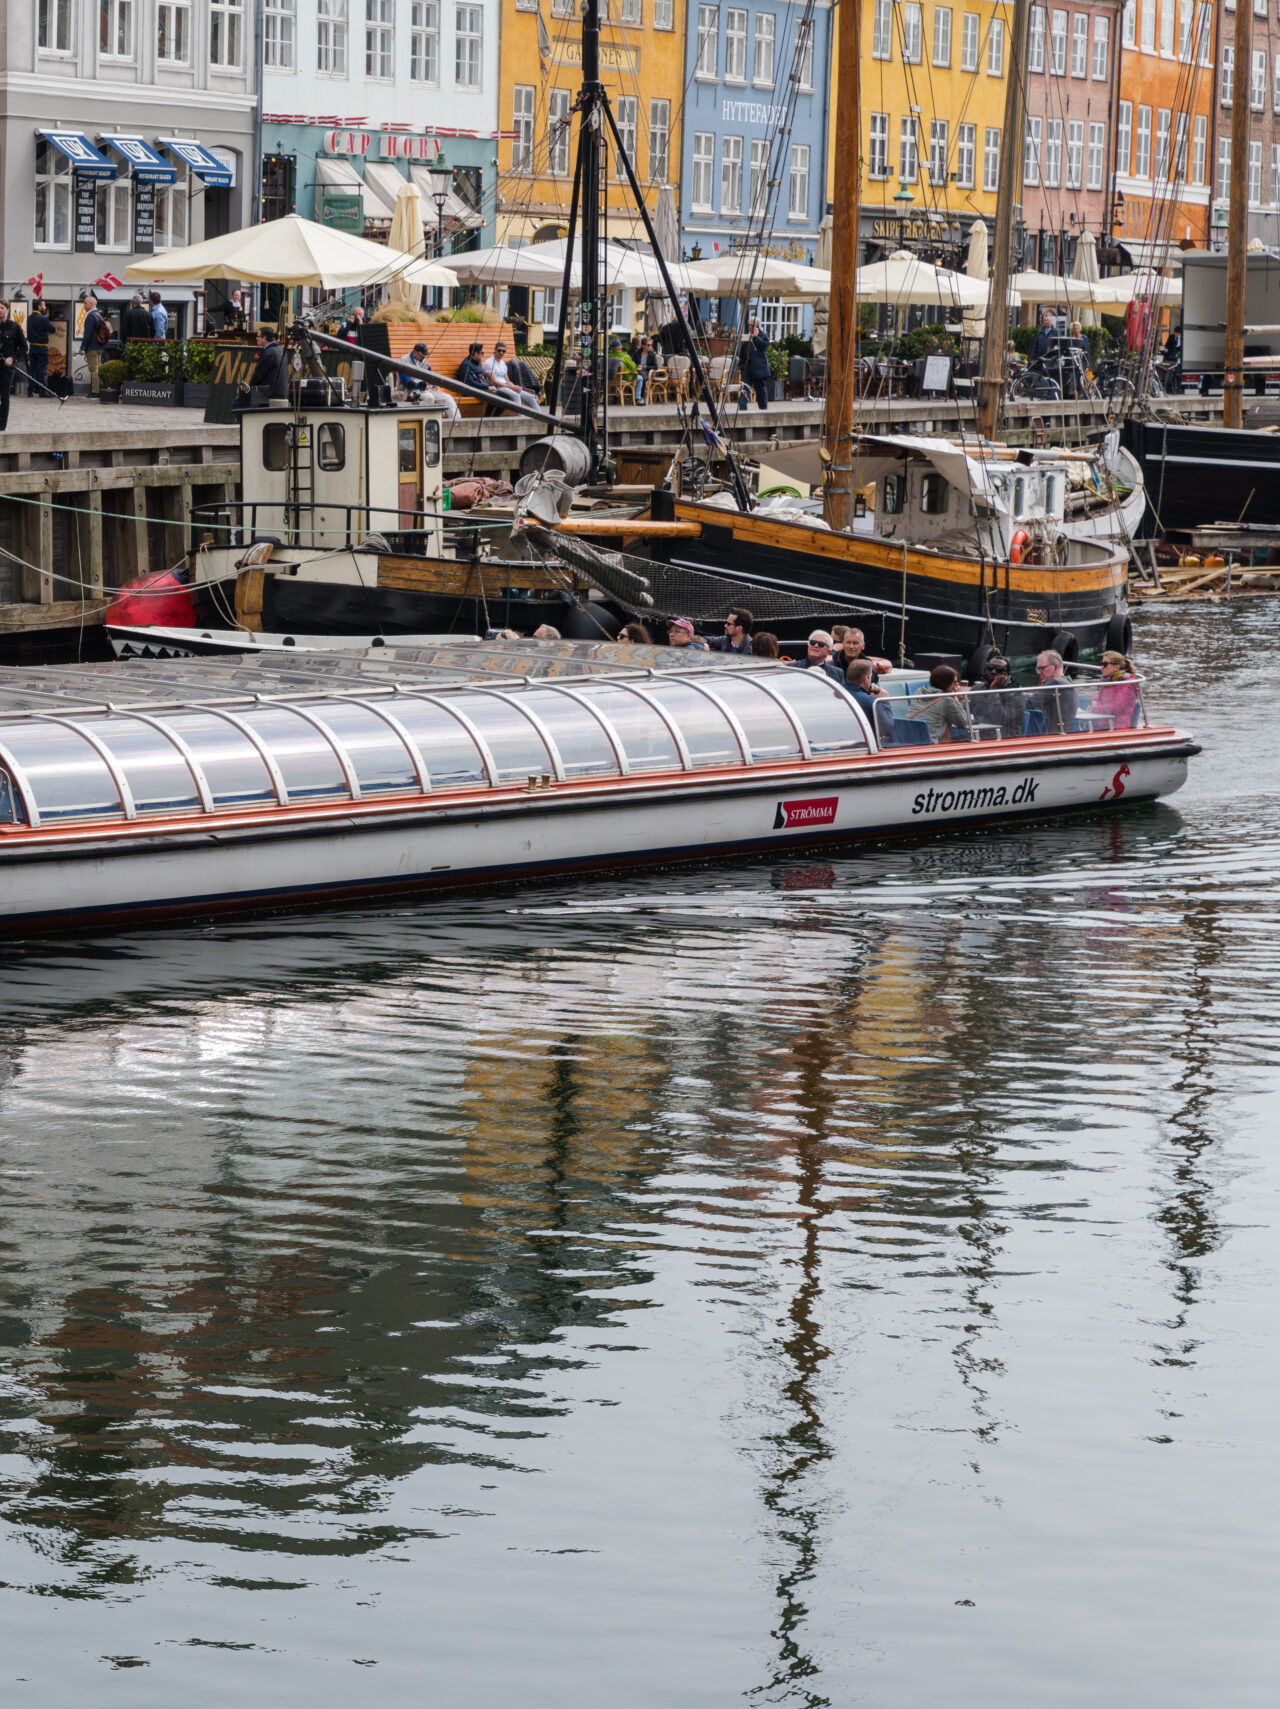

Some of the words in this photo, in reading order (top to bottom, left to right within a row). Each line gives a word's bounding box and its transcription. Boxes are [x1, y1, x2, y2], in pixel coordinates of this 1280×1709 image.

[566, 43, 621, 65] GANEN
[325, 131, 370, 155] CAP
[381, 135, 442, 160] HORN
[125, 388, 172, 399] RESTAURANT
[912, 777, 1040, 815] stromma.dk
[790, 806, 833, 820] STRÖMMA
